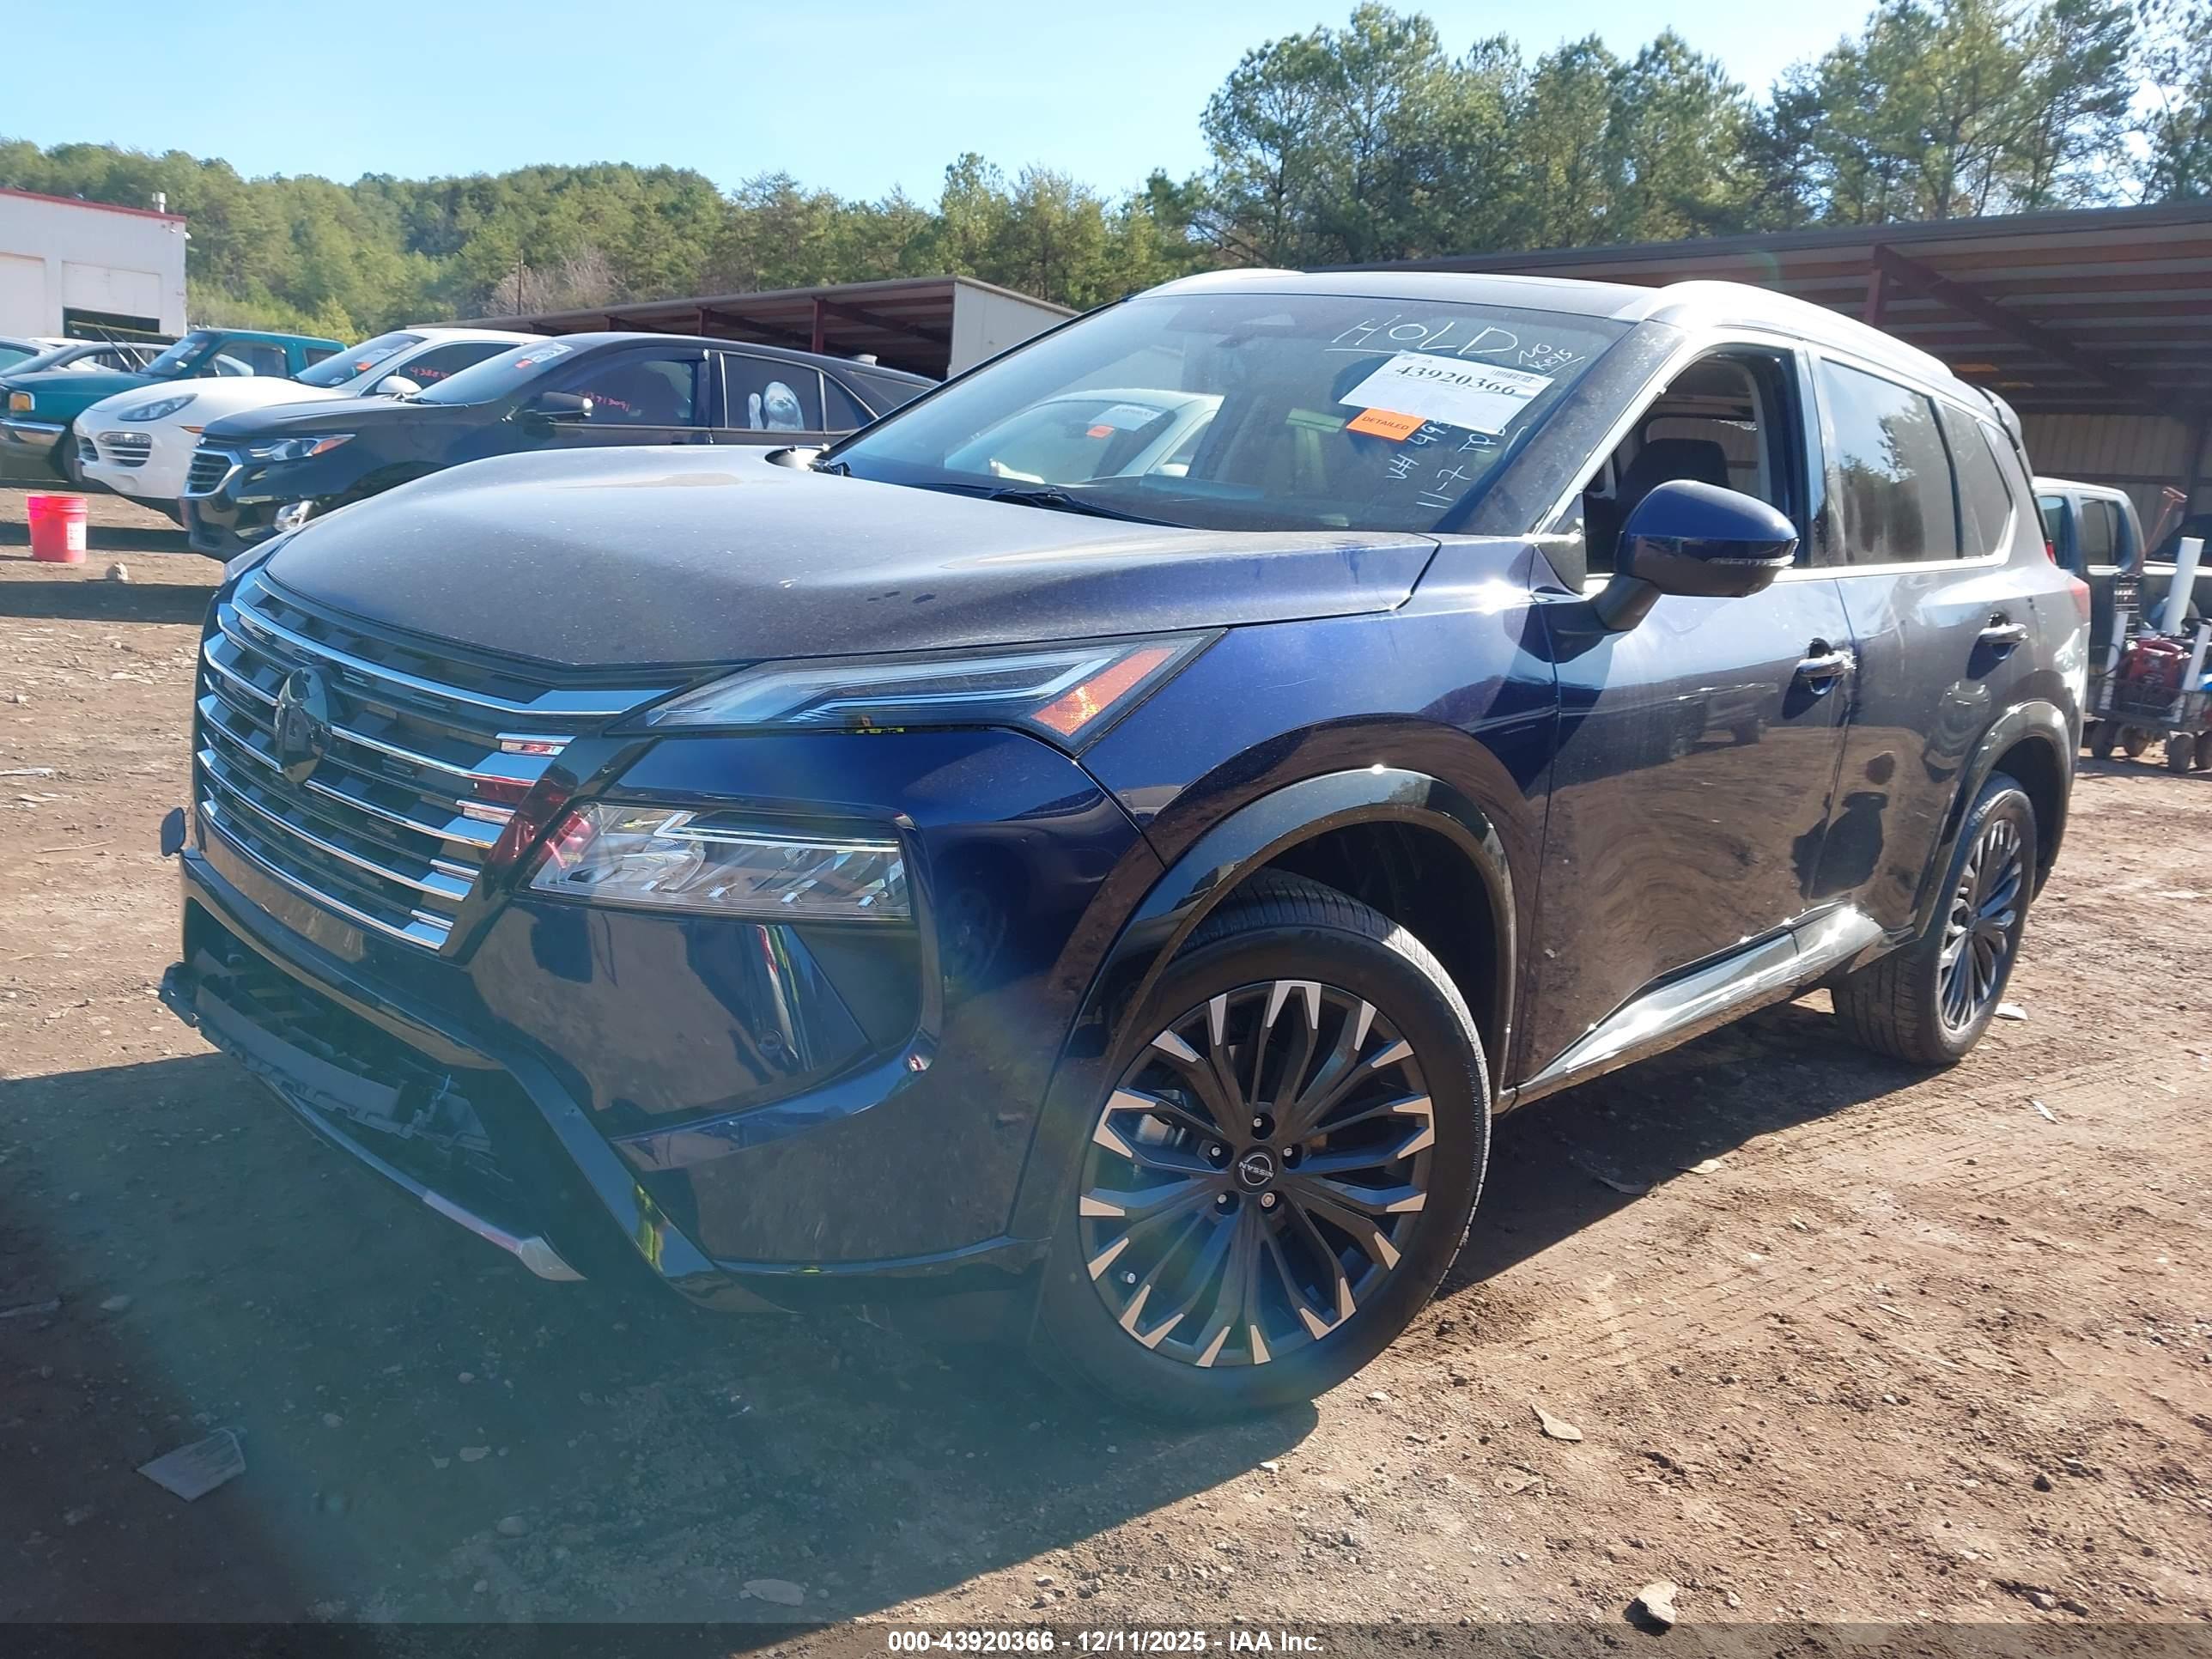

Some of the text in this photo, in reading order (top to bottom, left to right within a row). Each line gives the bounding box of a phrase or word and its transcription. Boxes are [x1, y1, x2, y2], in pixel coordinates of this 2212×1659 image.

[1332, 313, 1518, 356] HOLD
[1519, 343, 1552, 364] NO
[1395, 364, 1518, 396] 43920366
[1361, 415, 1411, 431] DETAILED
[1238, 1161, 1274, 1178] NISSAN
